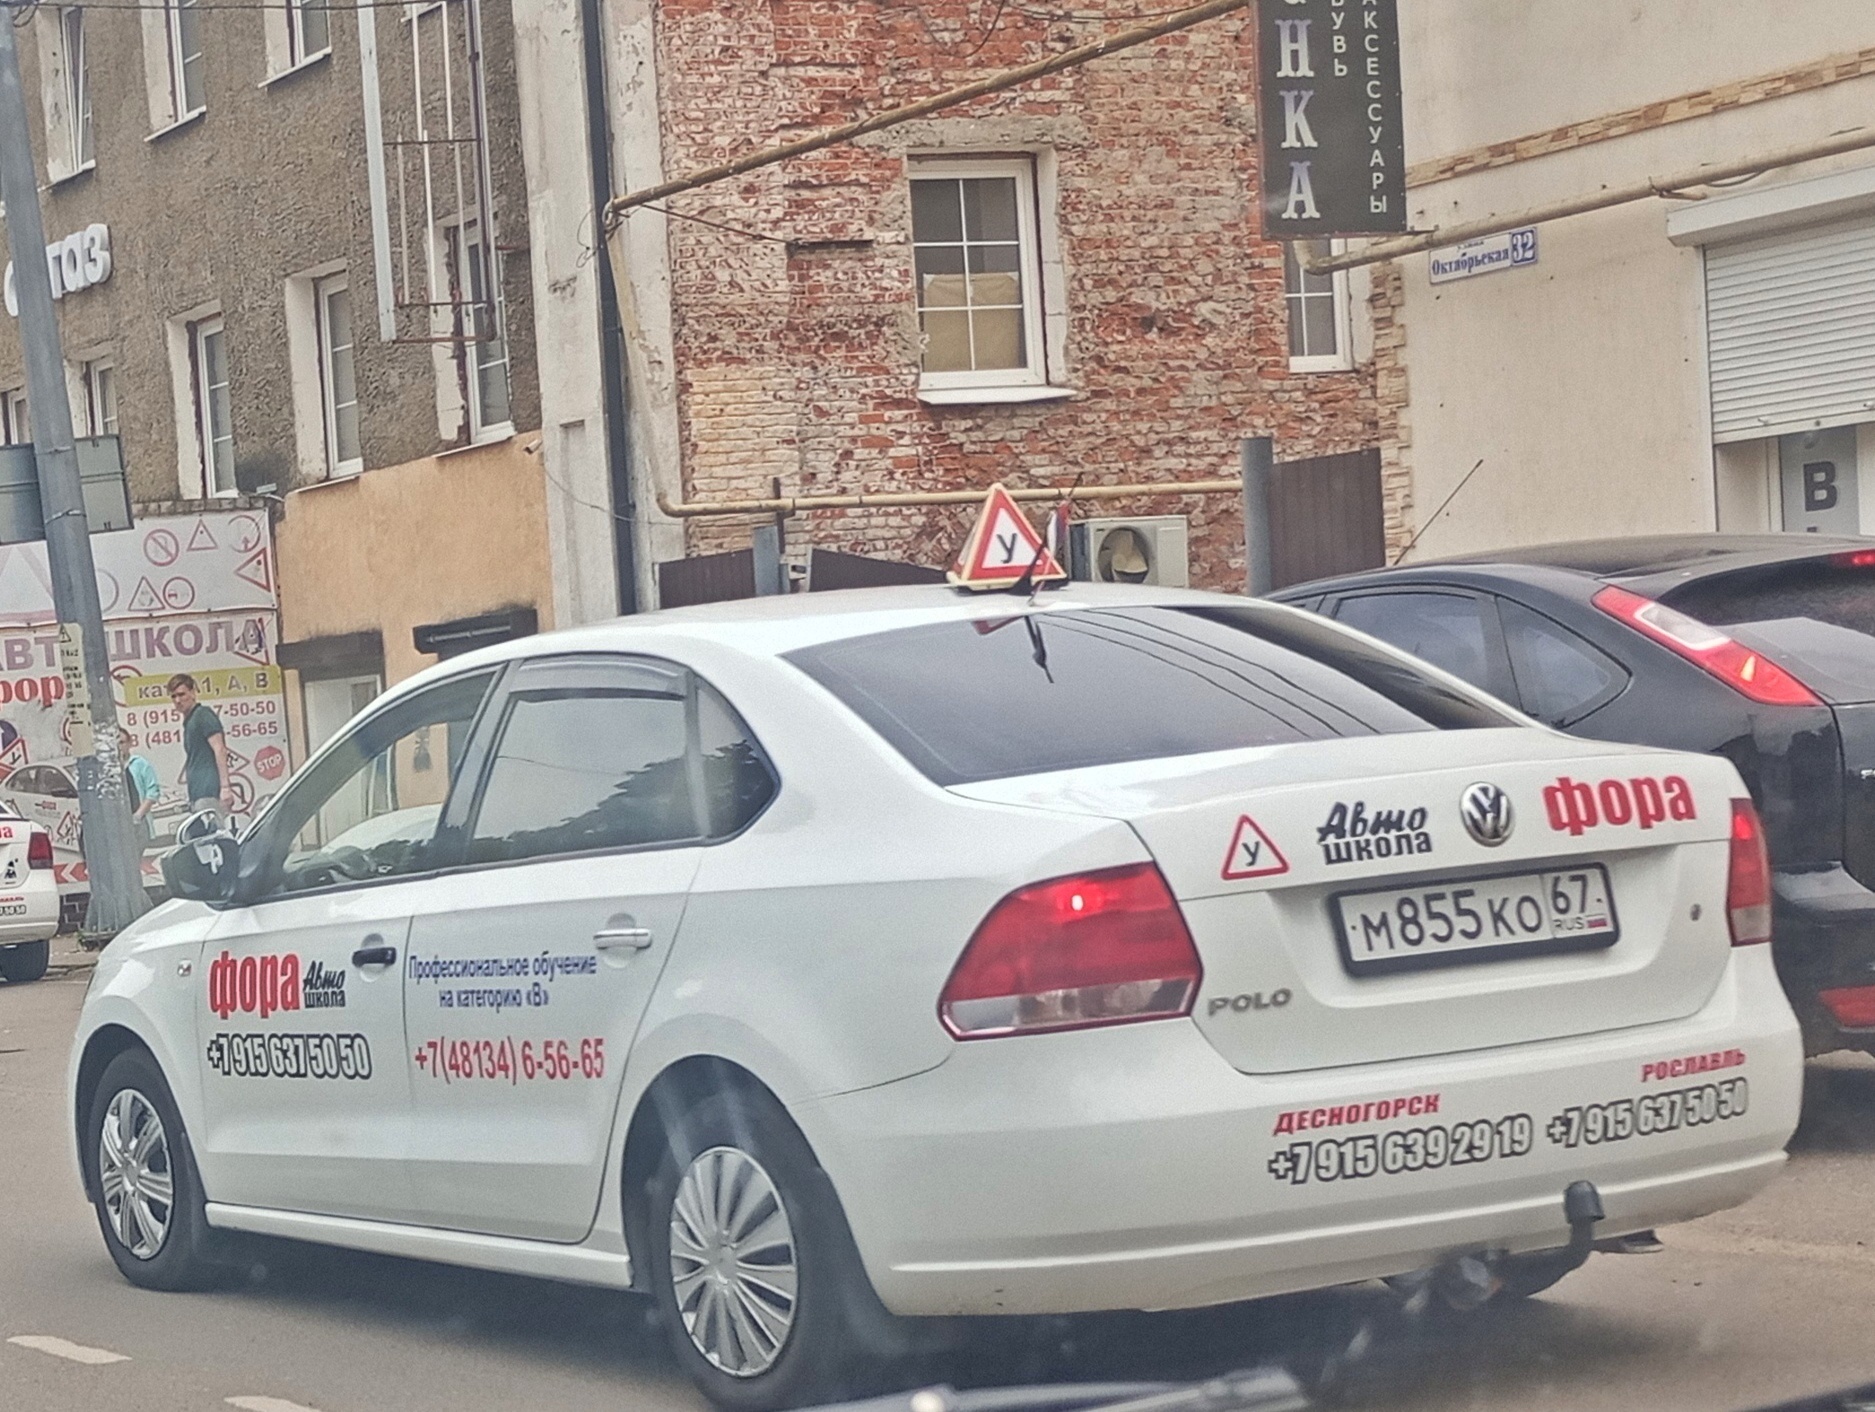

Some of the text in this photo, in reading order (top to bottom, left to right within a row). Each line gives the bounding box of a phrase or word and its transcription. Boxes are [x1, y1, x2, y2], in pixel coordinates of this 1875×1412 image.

[1274, 0, 1320, 219] НКА
[1362, 0, 1387, 213] КСЕССУАРЫ
[1432, 248, 1509, 276] Октябрьская
[1513, 231, 1535, 262] 32
[996, 533, 1017, 564] У
[255, 672, 269, 688] В
[127, 712, 138, 726] 8
[256, 754, 282, 773] STOP
[1317, 801, 1428, 844] Авто
[1242, 841, 1260, 867] У
[1323, 831, 1433, 865] школа
[1551, 874, 1588, 915] 67
[1553, 916, 1585, 930] RUS
[303, 960, 346, 991] Авто
[409, 951, 597, 985] Профессиональное обучение
[304, 990, 346, 1008] школа
[439, 990, 453, 1007] на
[457, 989, 522, 1013] категорию
[1207, 988, 1292, 1016] POLO
[521, 1039, 604, 1079] 6-56-65
[1641, 1049, 1746, 1082] РОСЛАВЛЬ
[1273, 1094, 1440, 1136] ДЕСНОГОРСК
